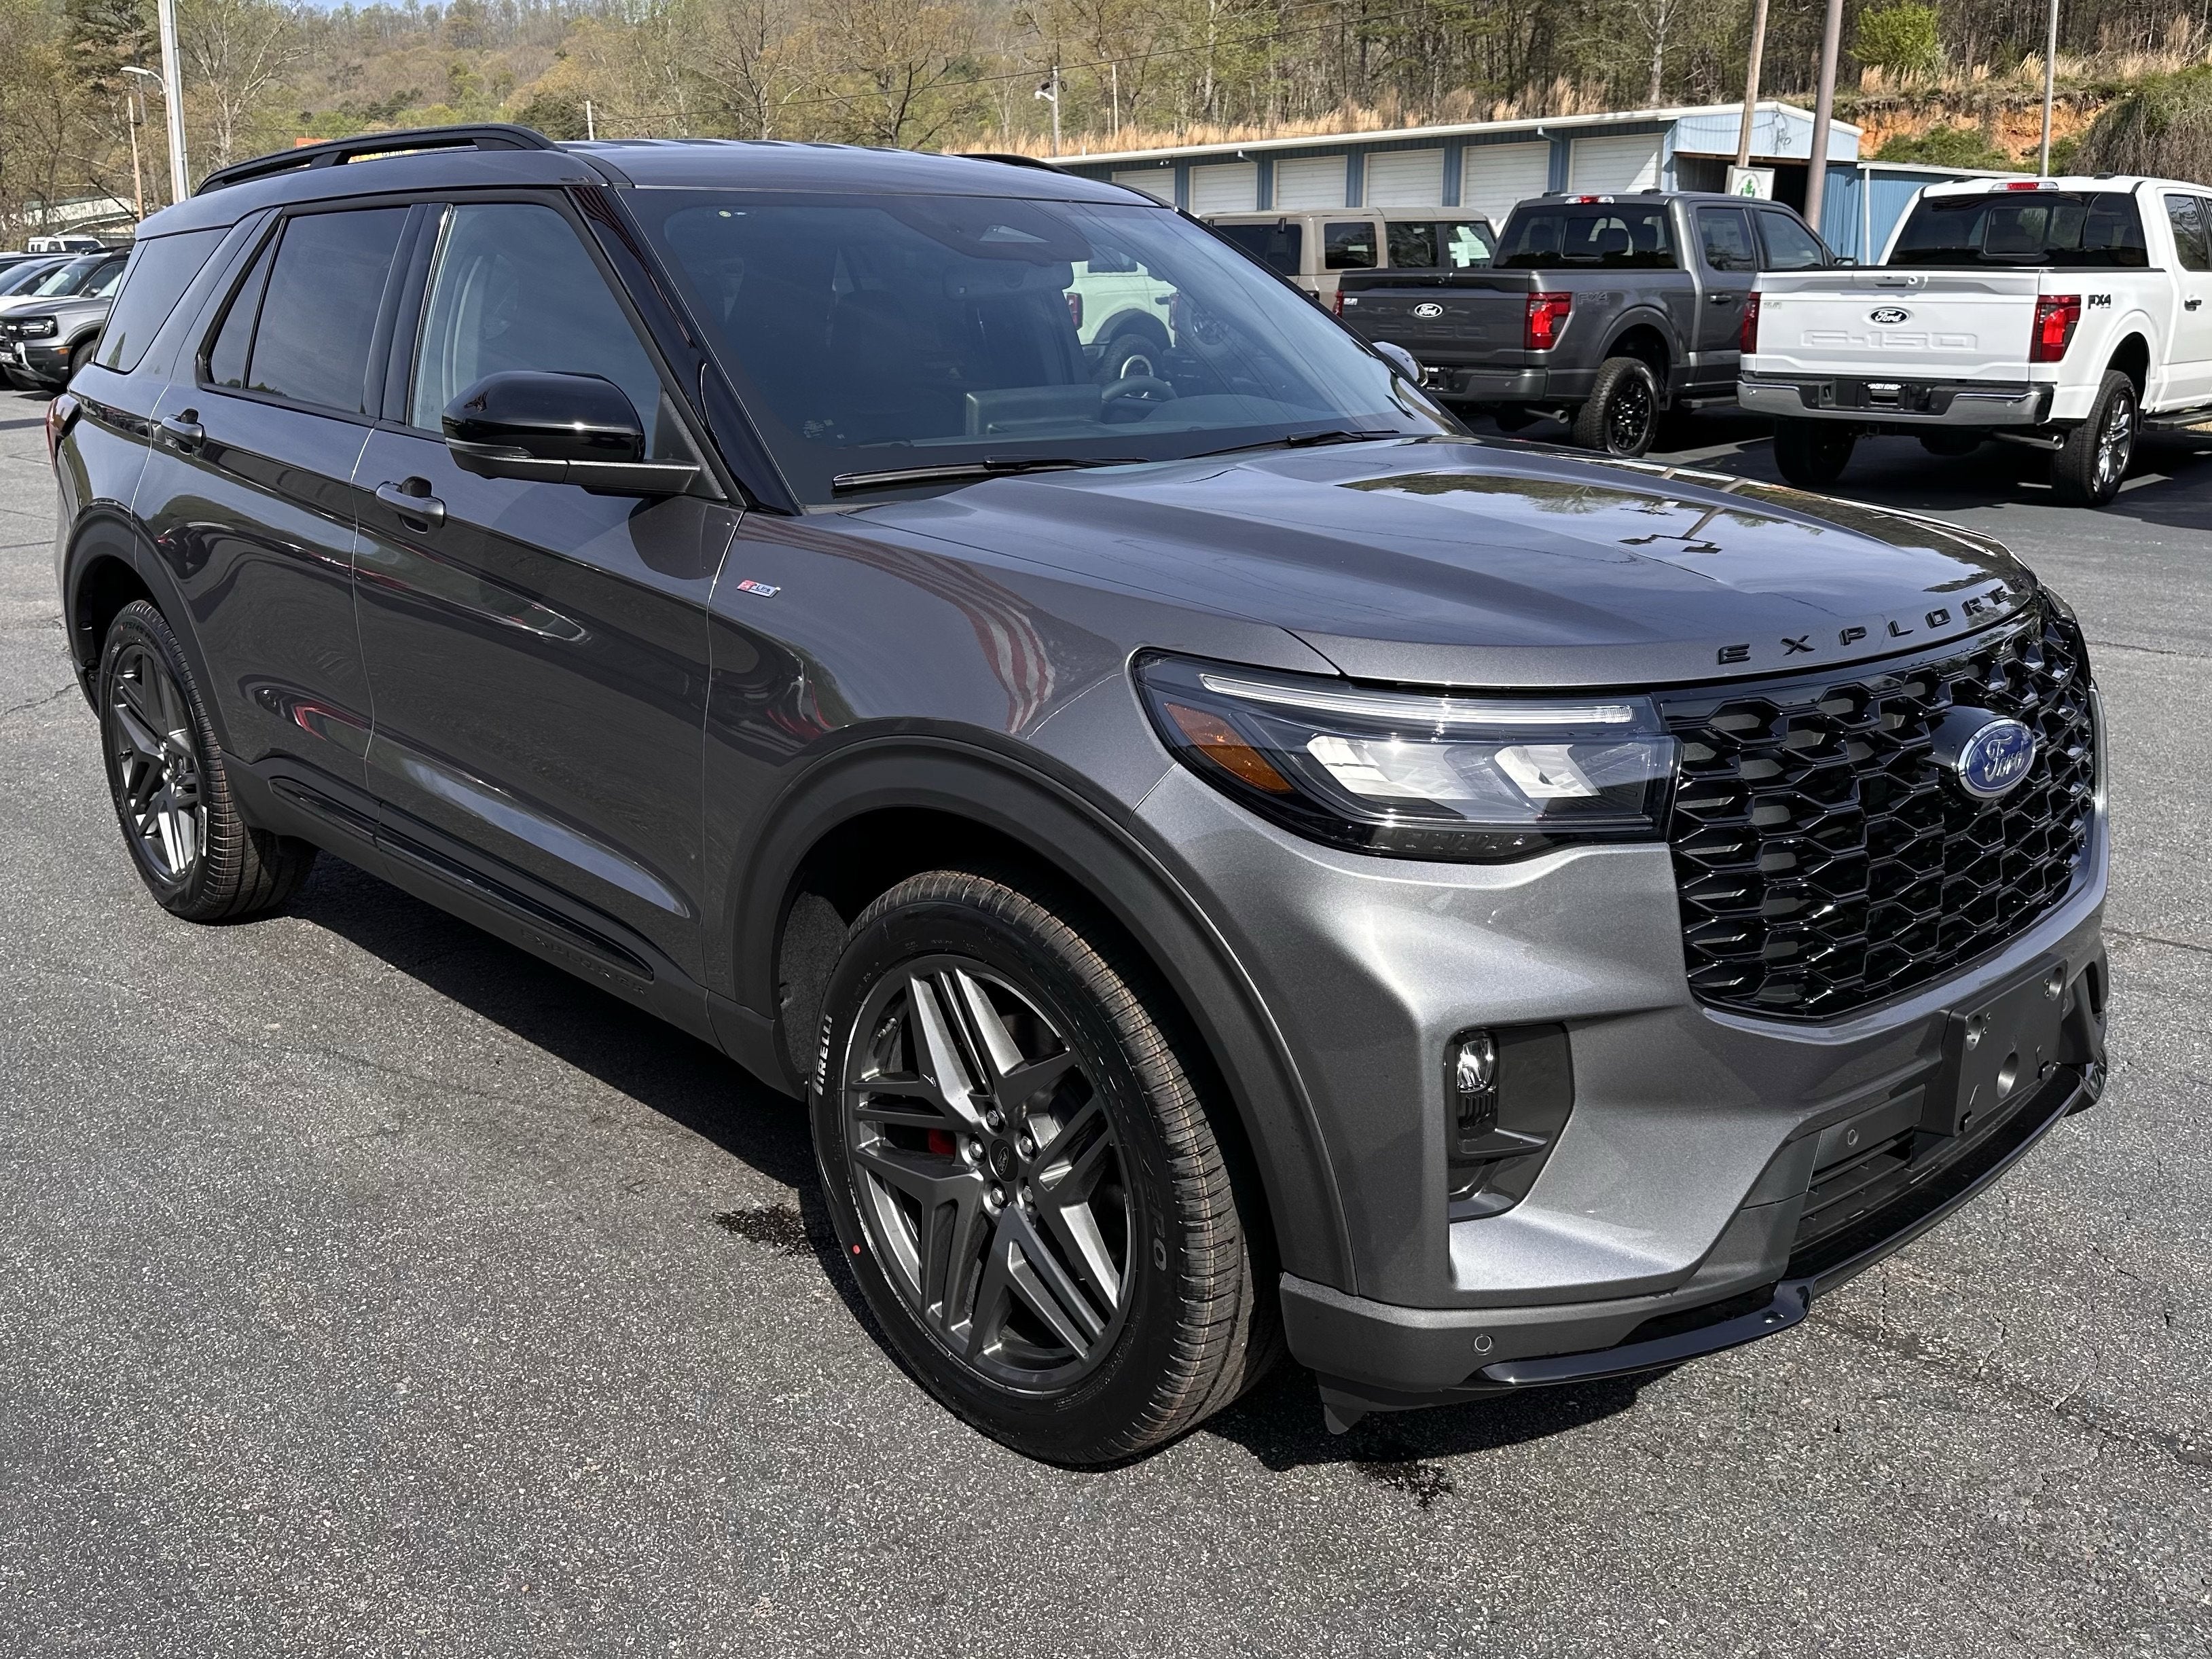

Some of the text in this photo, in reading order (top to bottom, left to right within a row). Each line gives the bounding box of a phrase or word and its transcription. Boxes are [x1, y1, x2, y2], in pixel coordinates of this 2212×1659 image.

[1875, 310, 1902, 322] Ford
[2088, 294, 2110, 310] FX4
[1801, 330, 1978, 350] F-150
[1716, 575, 2025, 665] EXPLORER
[1984, 735, 2025, 782] Ford
[812, 1014, 833, 1095] PIRELLI
